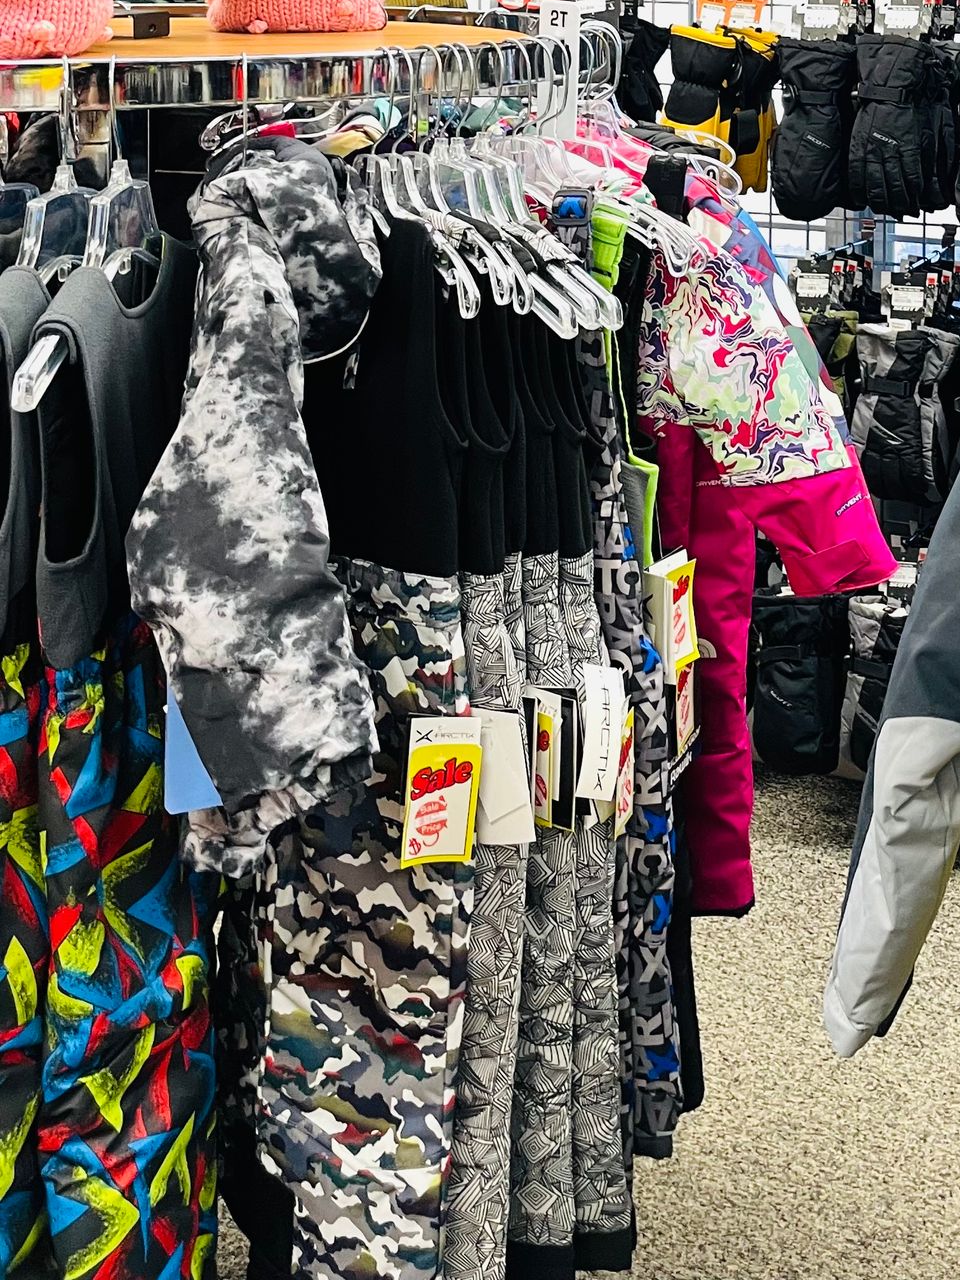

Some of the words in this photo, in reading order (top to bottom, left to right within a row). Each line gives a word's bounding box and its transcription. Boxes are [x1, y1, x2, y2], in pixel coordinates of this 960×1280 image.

[550, 9, 569, 28] 2T
[594, 687, 611, 791] ARCTIX
[410, 757, 473, 801] Sale
